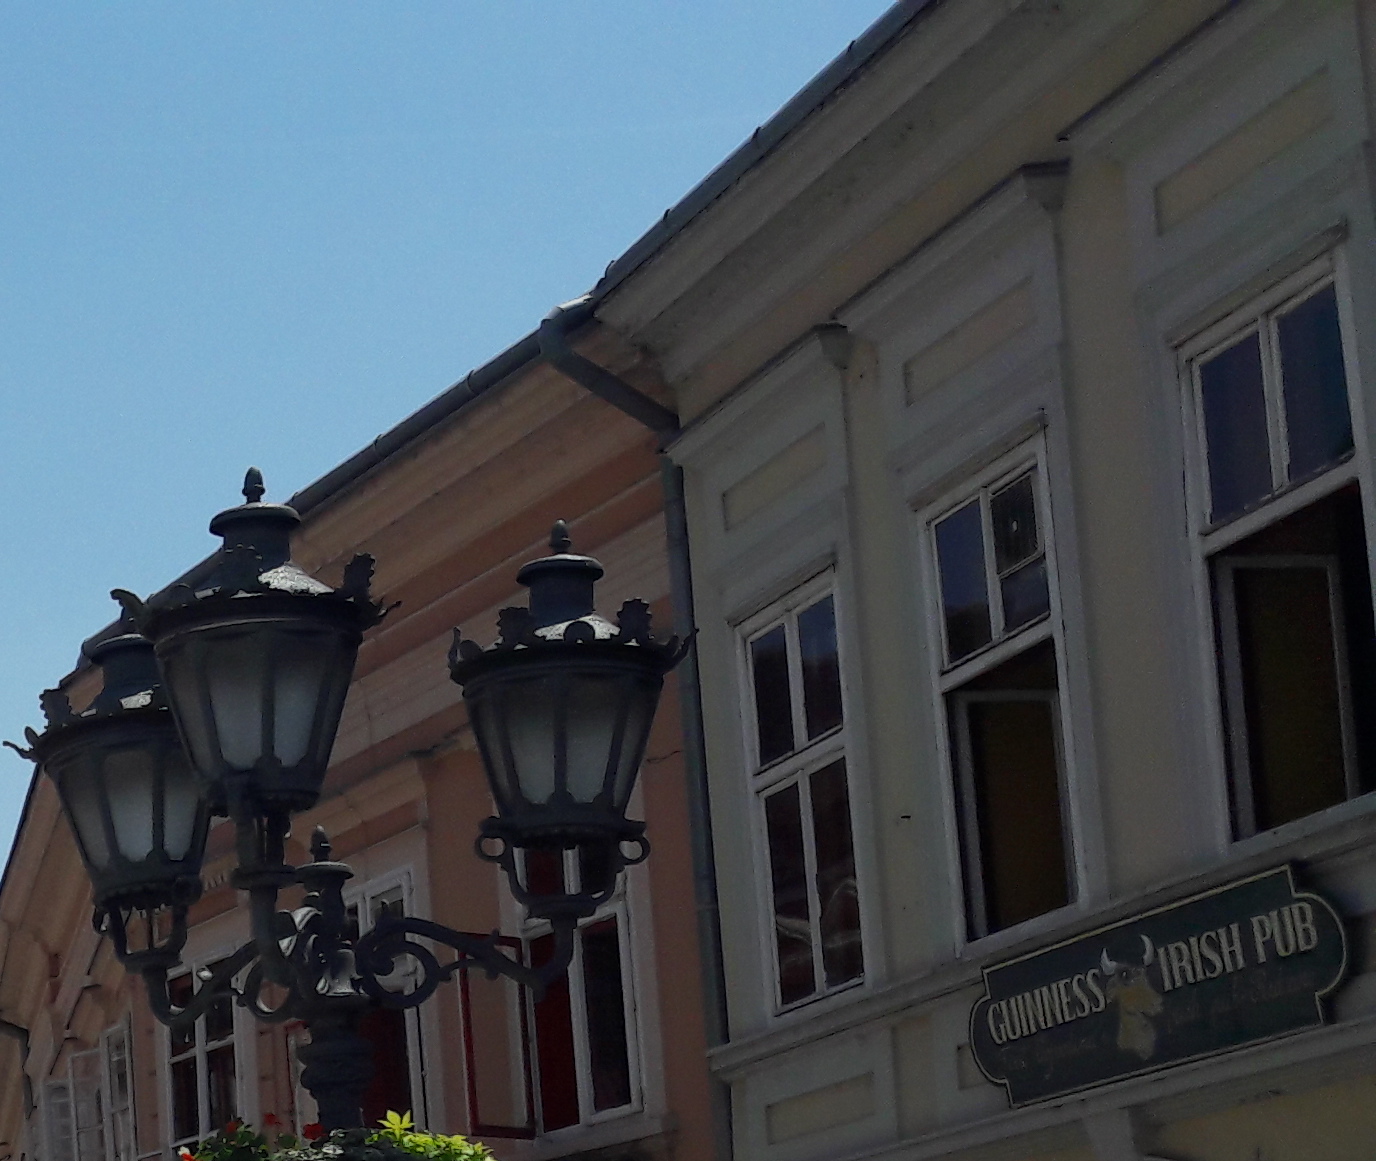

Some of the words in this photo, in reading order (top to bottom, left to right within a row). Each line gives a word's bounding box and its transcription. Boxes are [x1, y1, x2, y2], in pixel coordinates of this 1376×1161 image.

[986, 967, 1107, 1046] GUINNESS
[1156, 922, 1247, 992] IRISH
[1250, 902, 1319, 965] PUB
